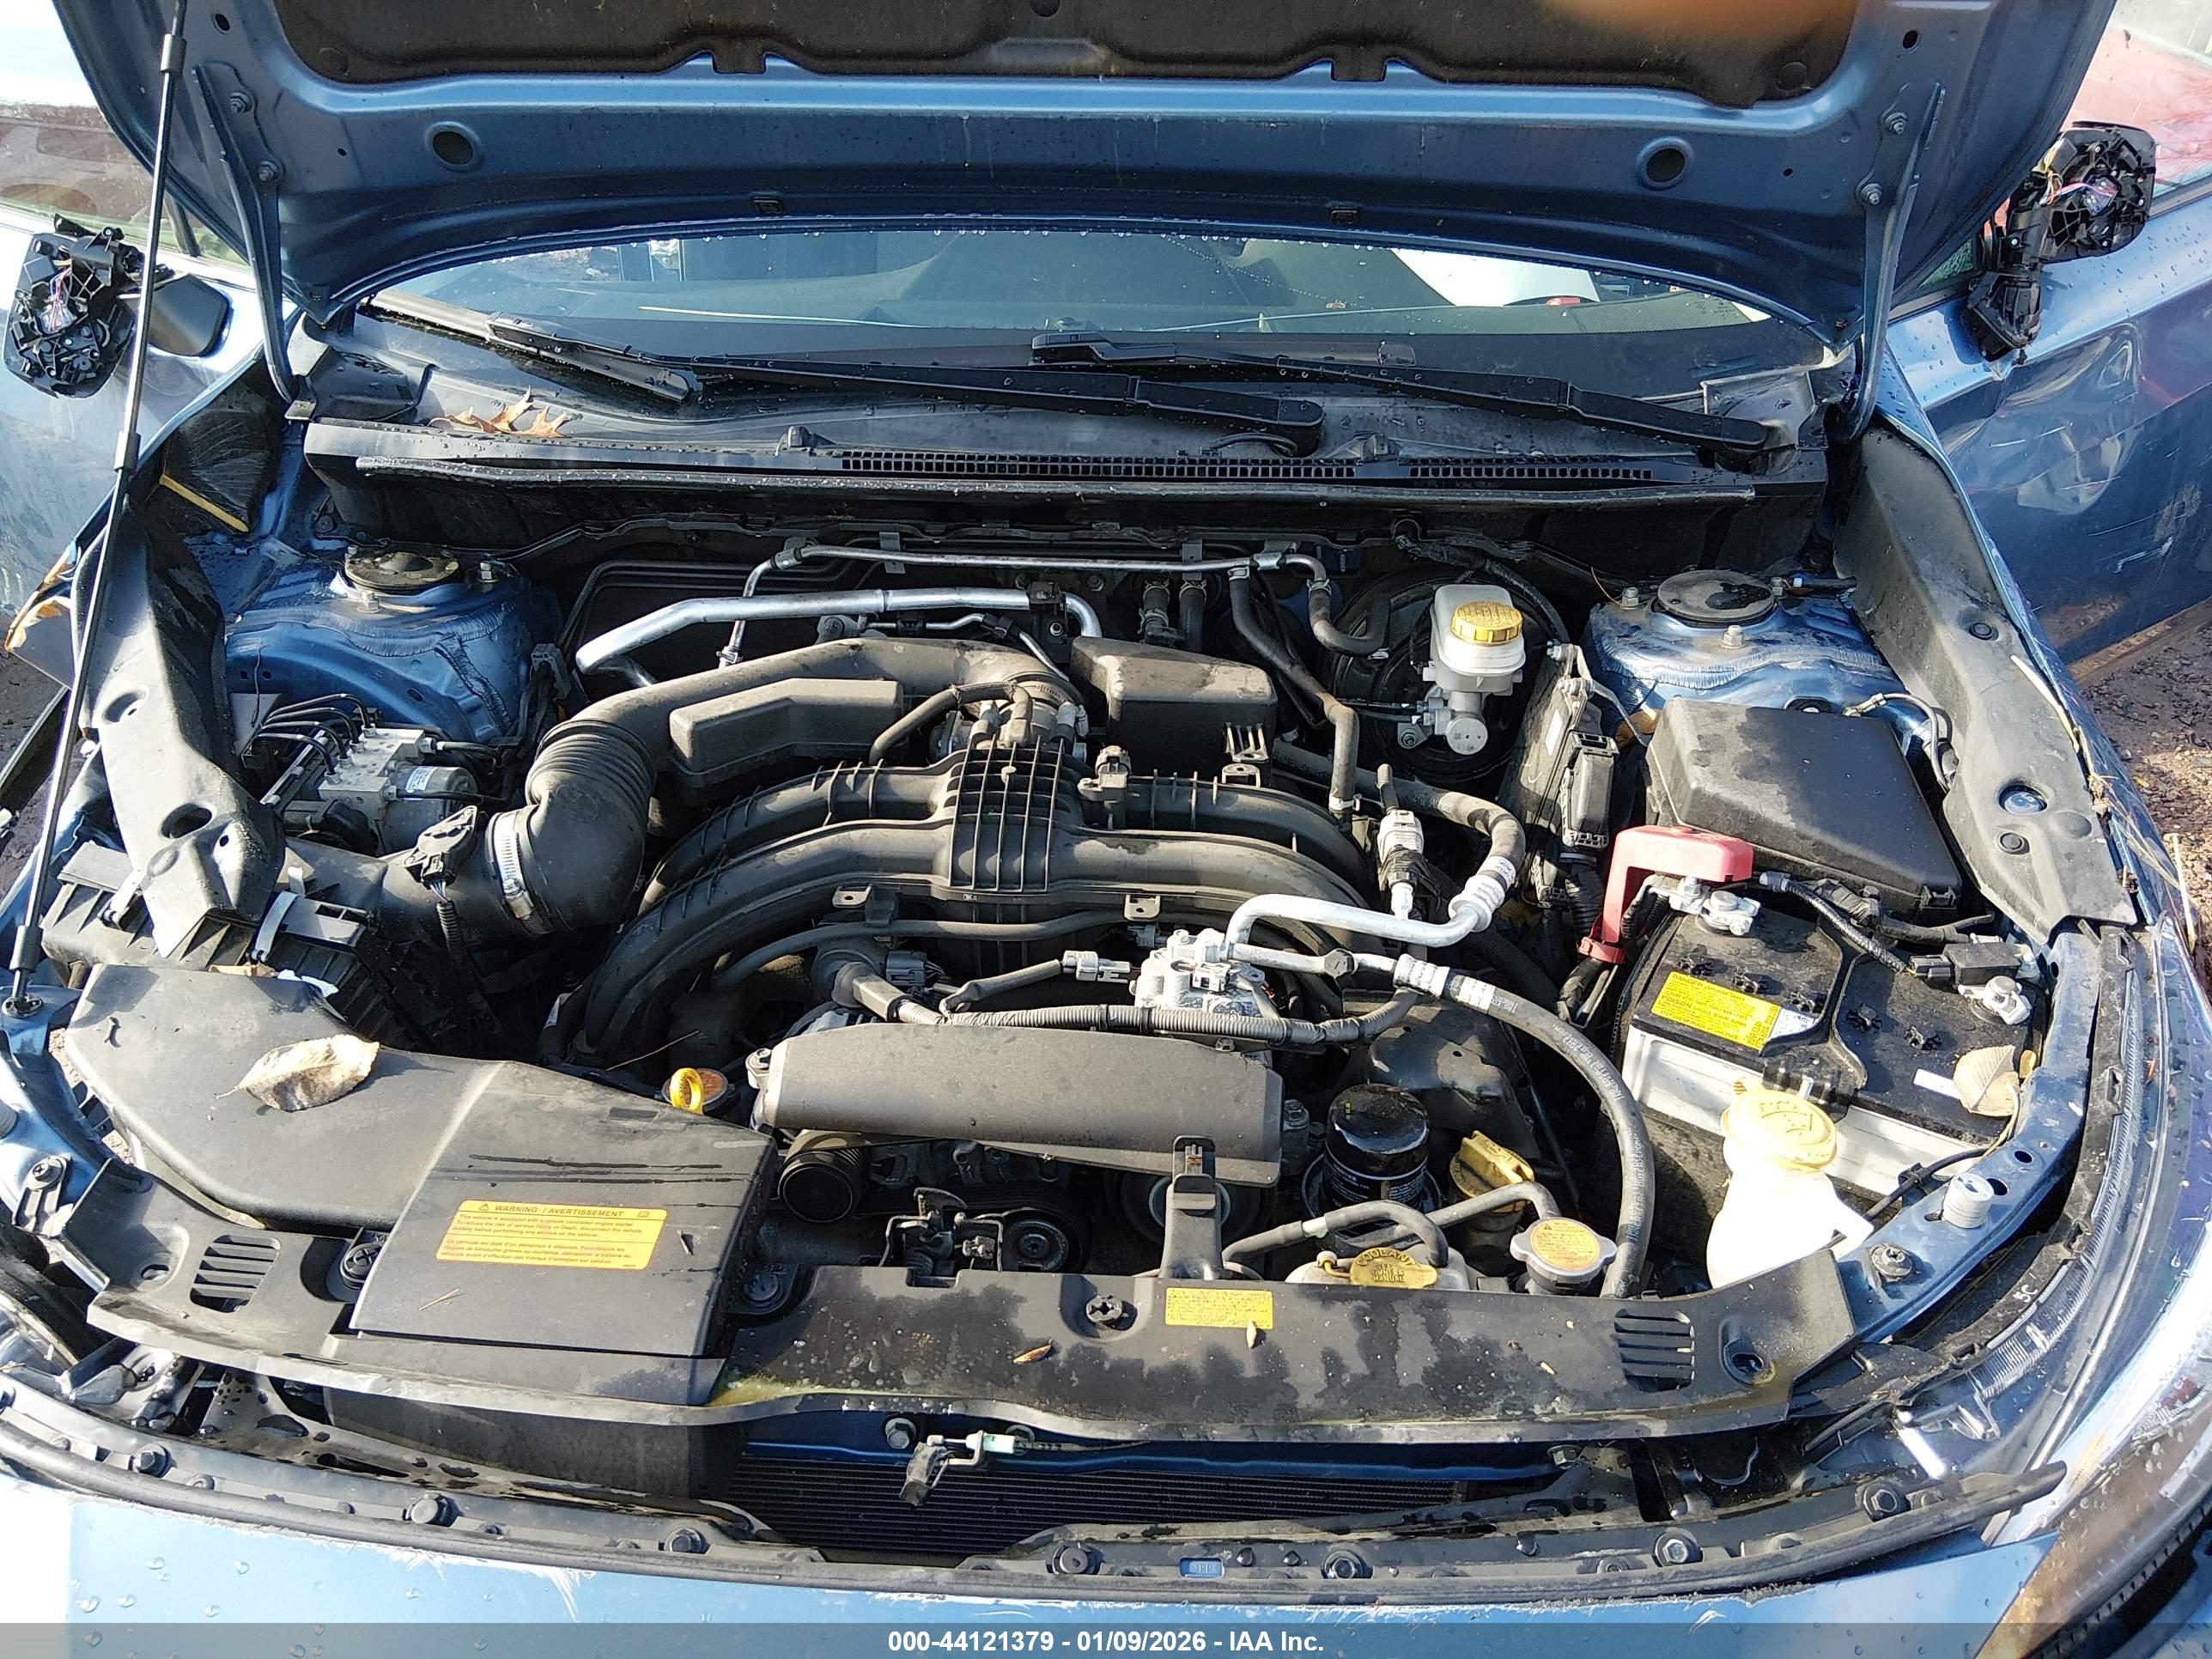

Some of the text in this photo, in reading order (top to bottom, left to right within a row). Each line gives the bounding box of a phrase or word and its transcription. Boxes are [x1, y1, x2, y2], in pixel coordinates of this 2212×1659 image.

[1661, 994, 1691, 1008] POISON
[548, 1208, 624, 1217] AVERTISSEMENT
[1357, 1249, 1416, 1266] COOLANT
